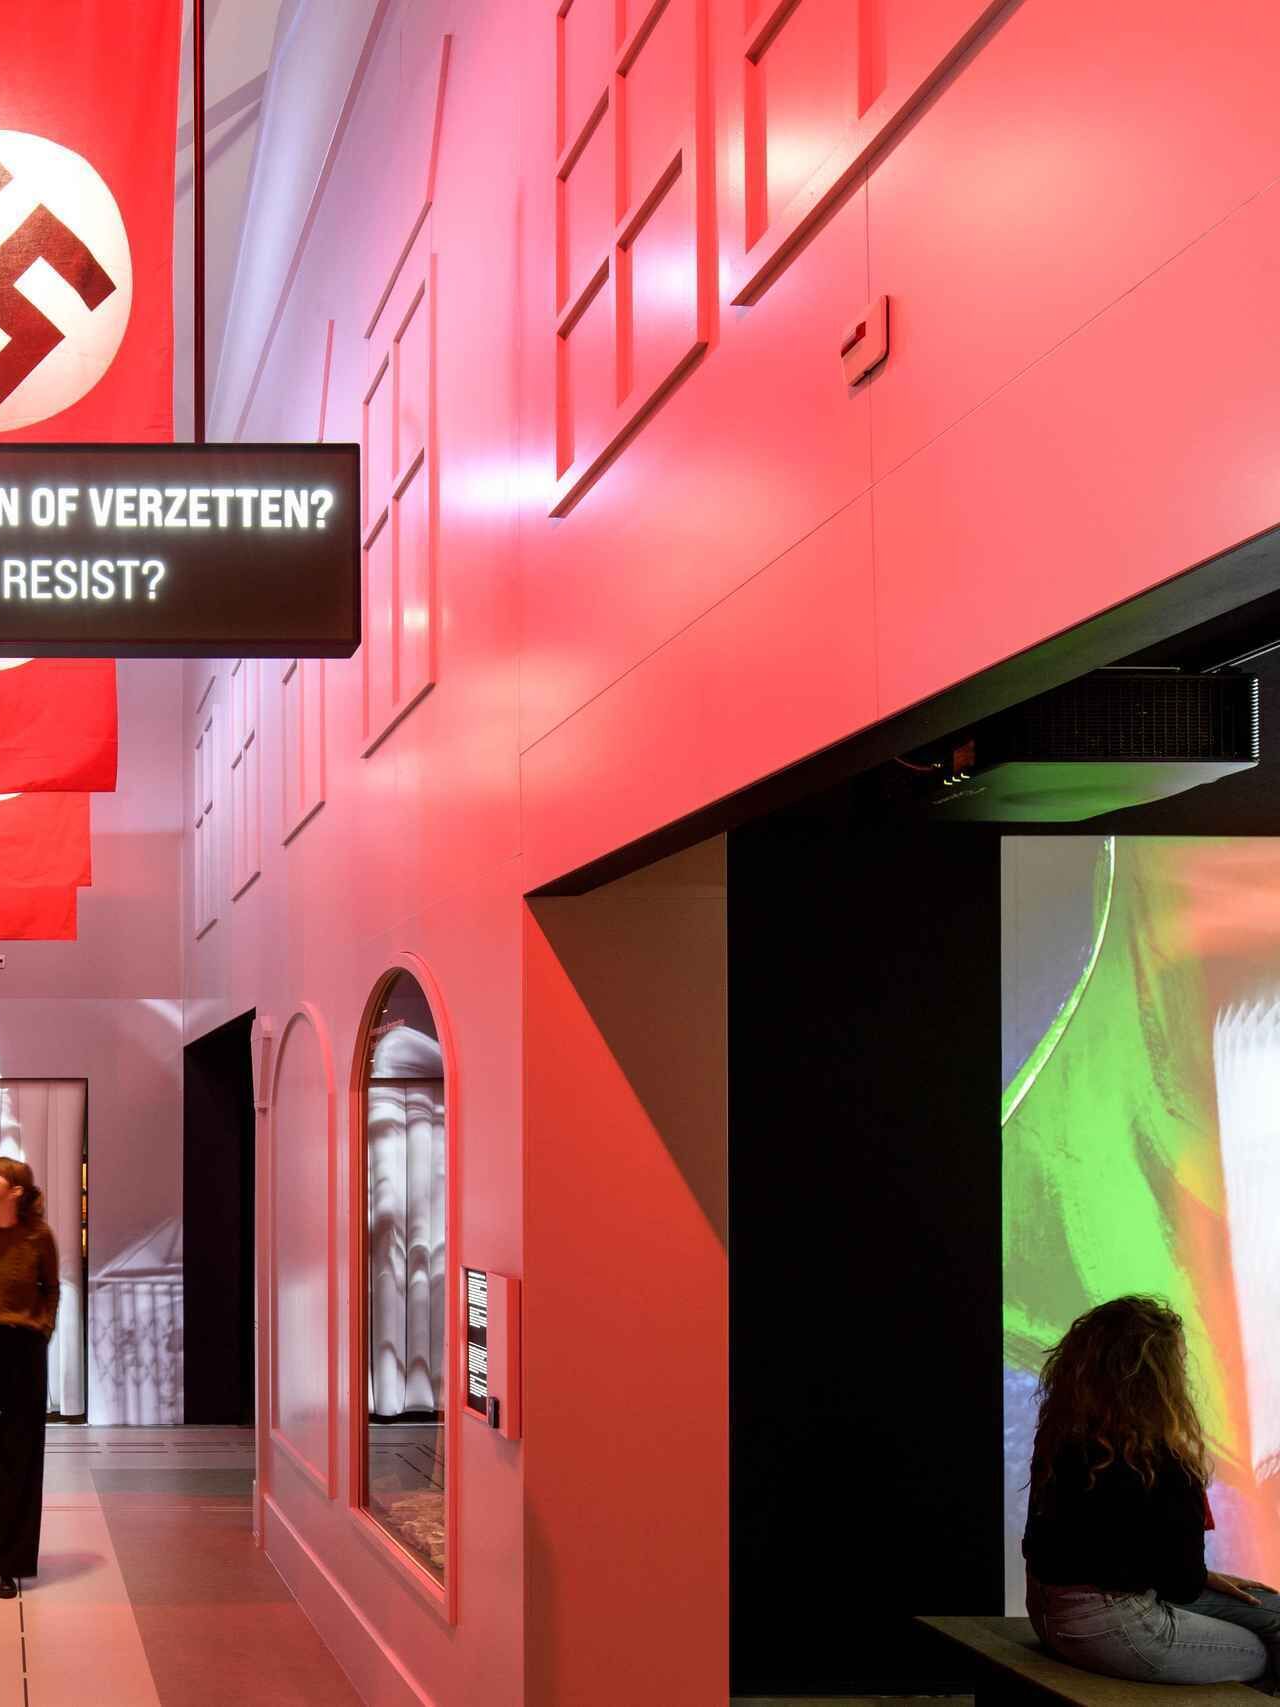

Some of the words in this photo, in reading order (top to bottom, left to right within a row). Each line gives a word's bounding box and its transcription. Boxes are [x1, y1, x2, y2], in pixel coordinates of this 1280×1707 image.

[31, 487, 79, 528] OF
[88, 488, 334, 528] VERZETTEN?
[3, 560, 165, 601] RESIST?
